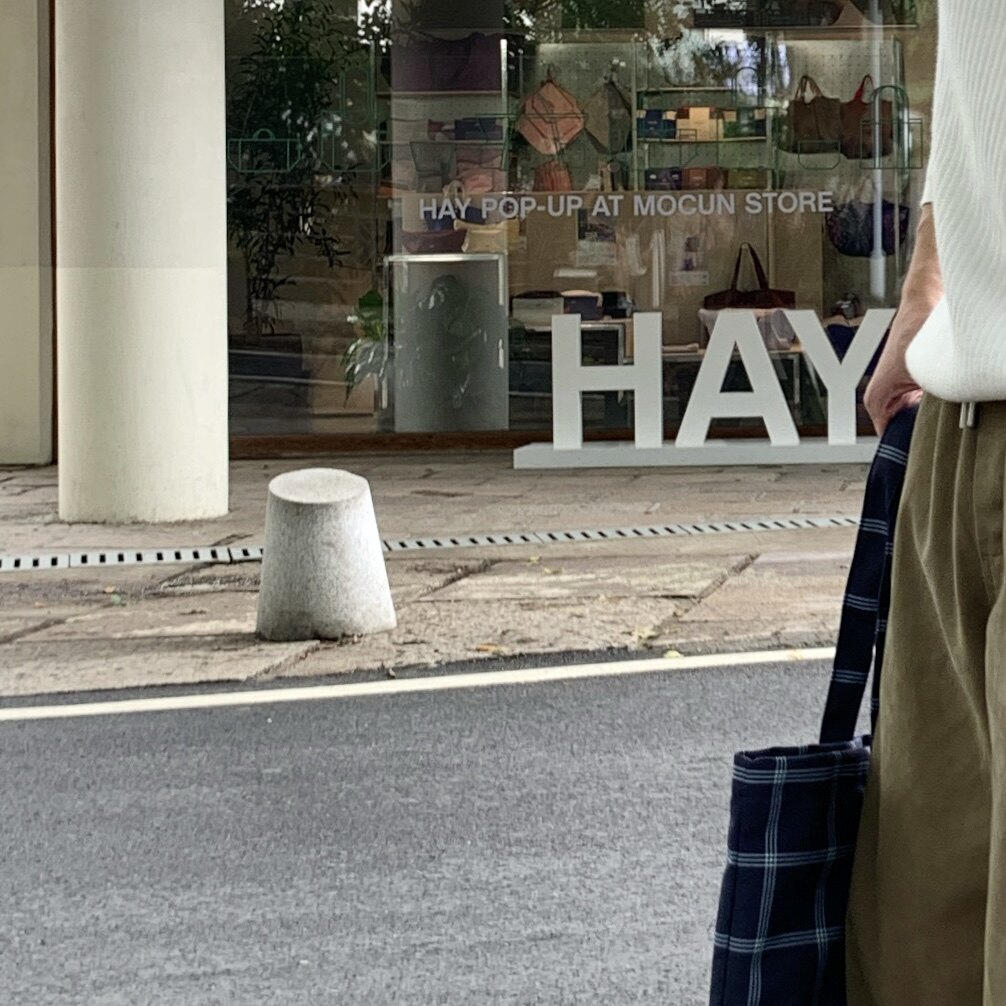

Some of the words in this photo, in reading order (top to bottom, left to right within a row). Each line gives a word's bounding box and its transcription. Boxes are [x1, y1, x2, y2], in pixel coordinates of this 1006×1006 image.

[419, 199, 472, 220] HAY
[481, 196, 583, 217] POP-UP
[591, 194, 624, 216] AT
[632, 193, 735, 216] MOCUN
[744, 191, 834, 214] STORE
[551, 308, 895, 450] HAY
